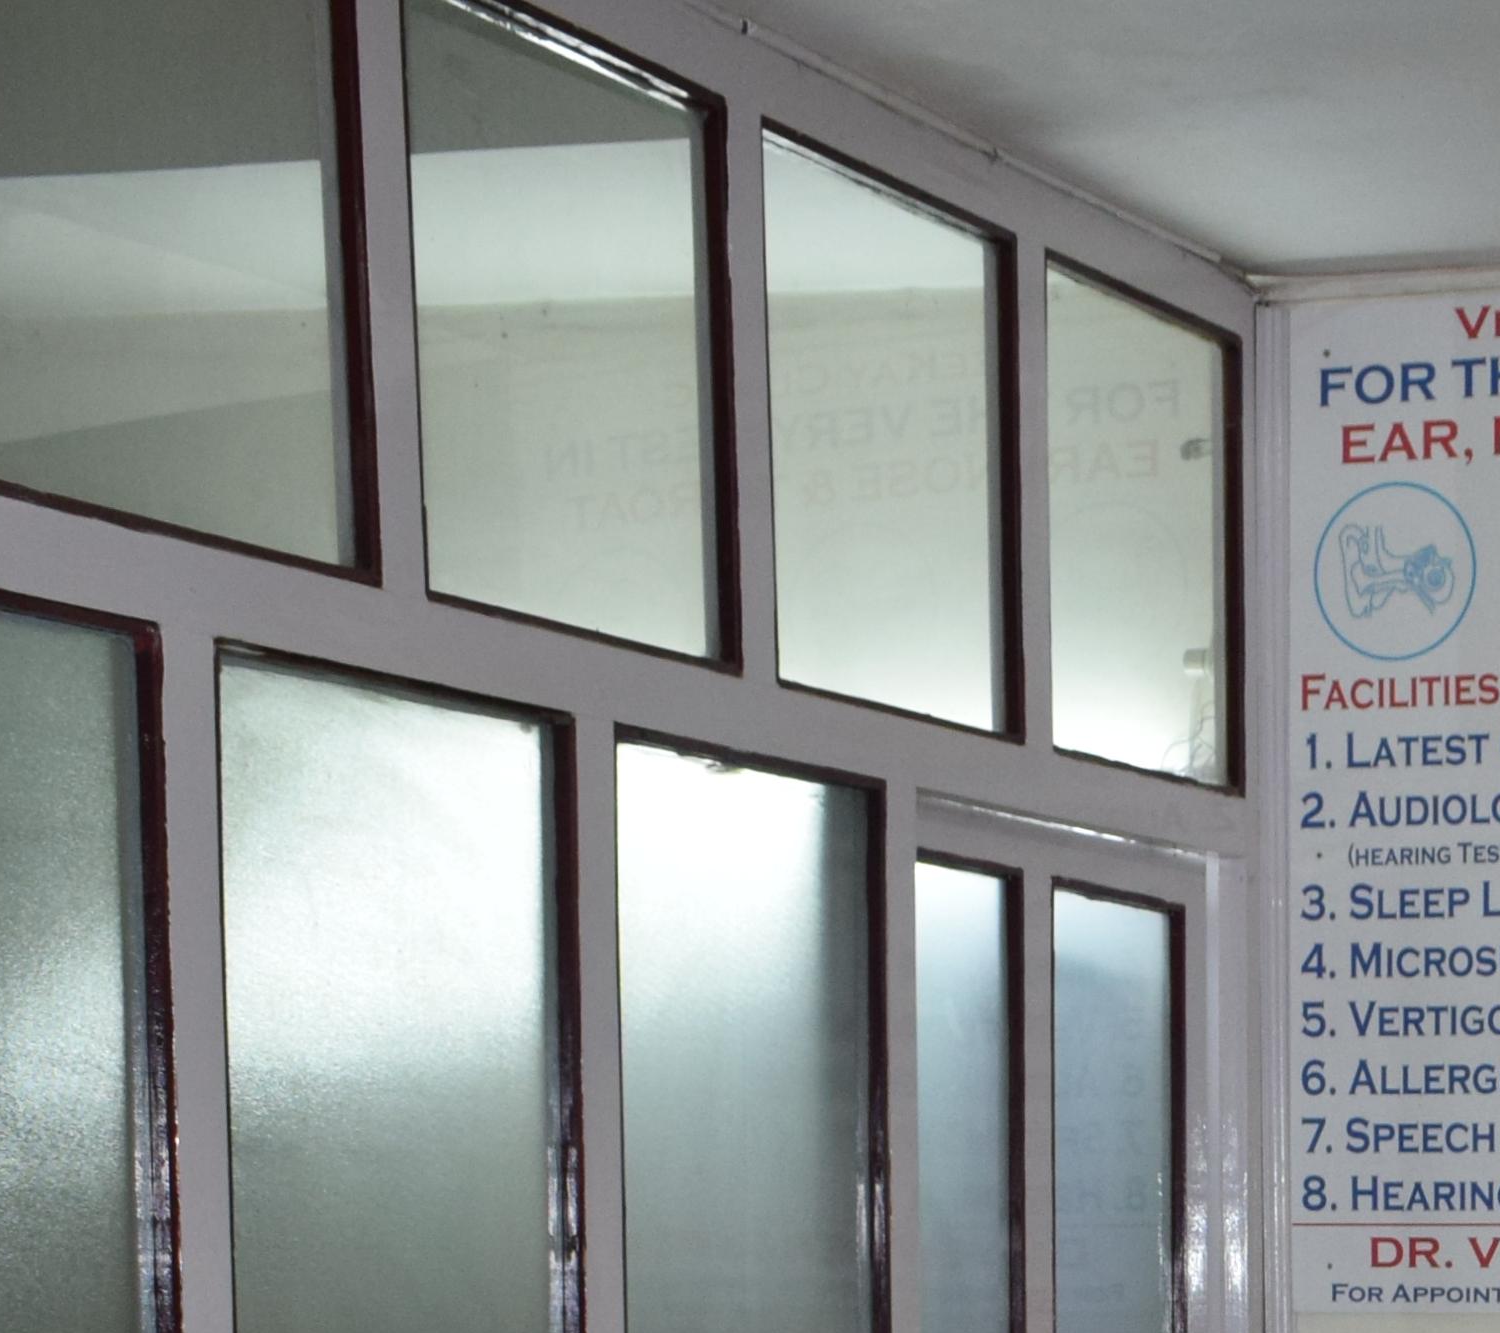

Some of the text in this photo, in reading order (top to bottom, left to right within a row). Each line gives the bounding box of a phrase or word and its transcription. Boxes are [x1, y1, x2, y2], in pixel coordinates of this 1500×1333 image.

[1319, 361, 1436, 408] FOR
[1341, 419, 1474, 465] EAR,
[1301, 672, 1500, 712] FACILITIES
[1306, 732, 1333, 771] 1.
[1346, 731, 1490, 769] LATEST
[1300, 791, 1336, 830] 2.
[1347, 842, 1452, 869] (HEARING
[1299, 883, 1337, 922] 3.
[1349, 882, 1471, 921] SLEEP
[1300, 942, 1337, 980] 4.
[1301, 1000, 1337, 1039] 5.
[1300, 1058, 1337, 1097] 6.
[1300, 1116, 1333, 1155] 7.
[1345, 1116, 1496, 1155] SPEECH
[1300, 1174, 1338, 1213] 8.
[1370, 1236, 1453, 1269] DR.
[1331, 1283, 1384, 1303] FOR
